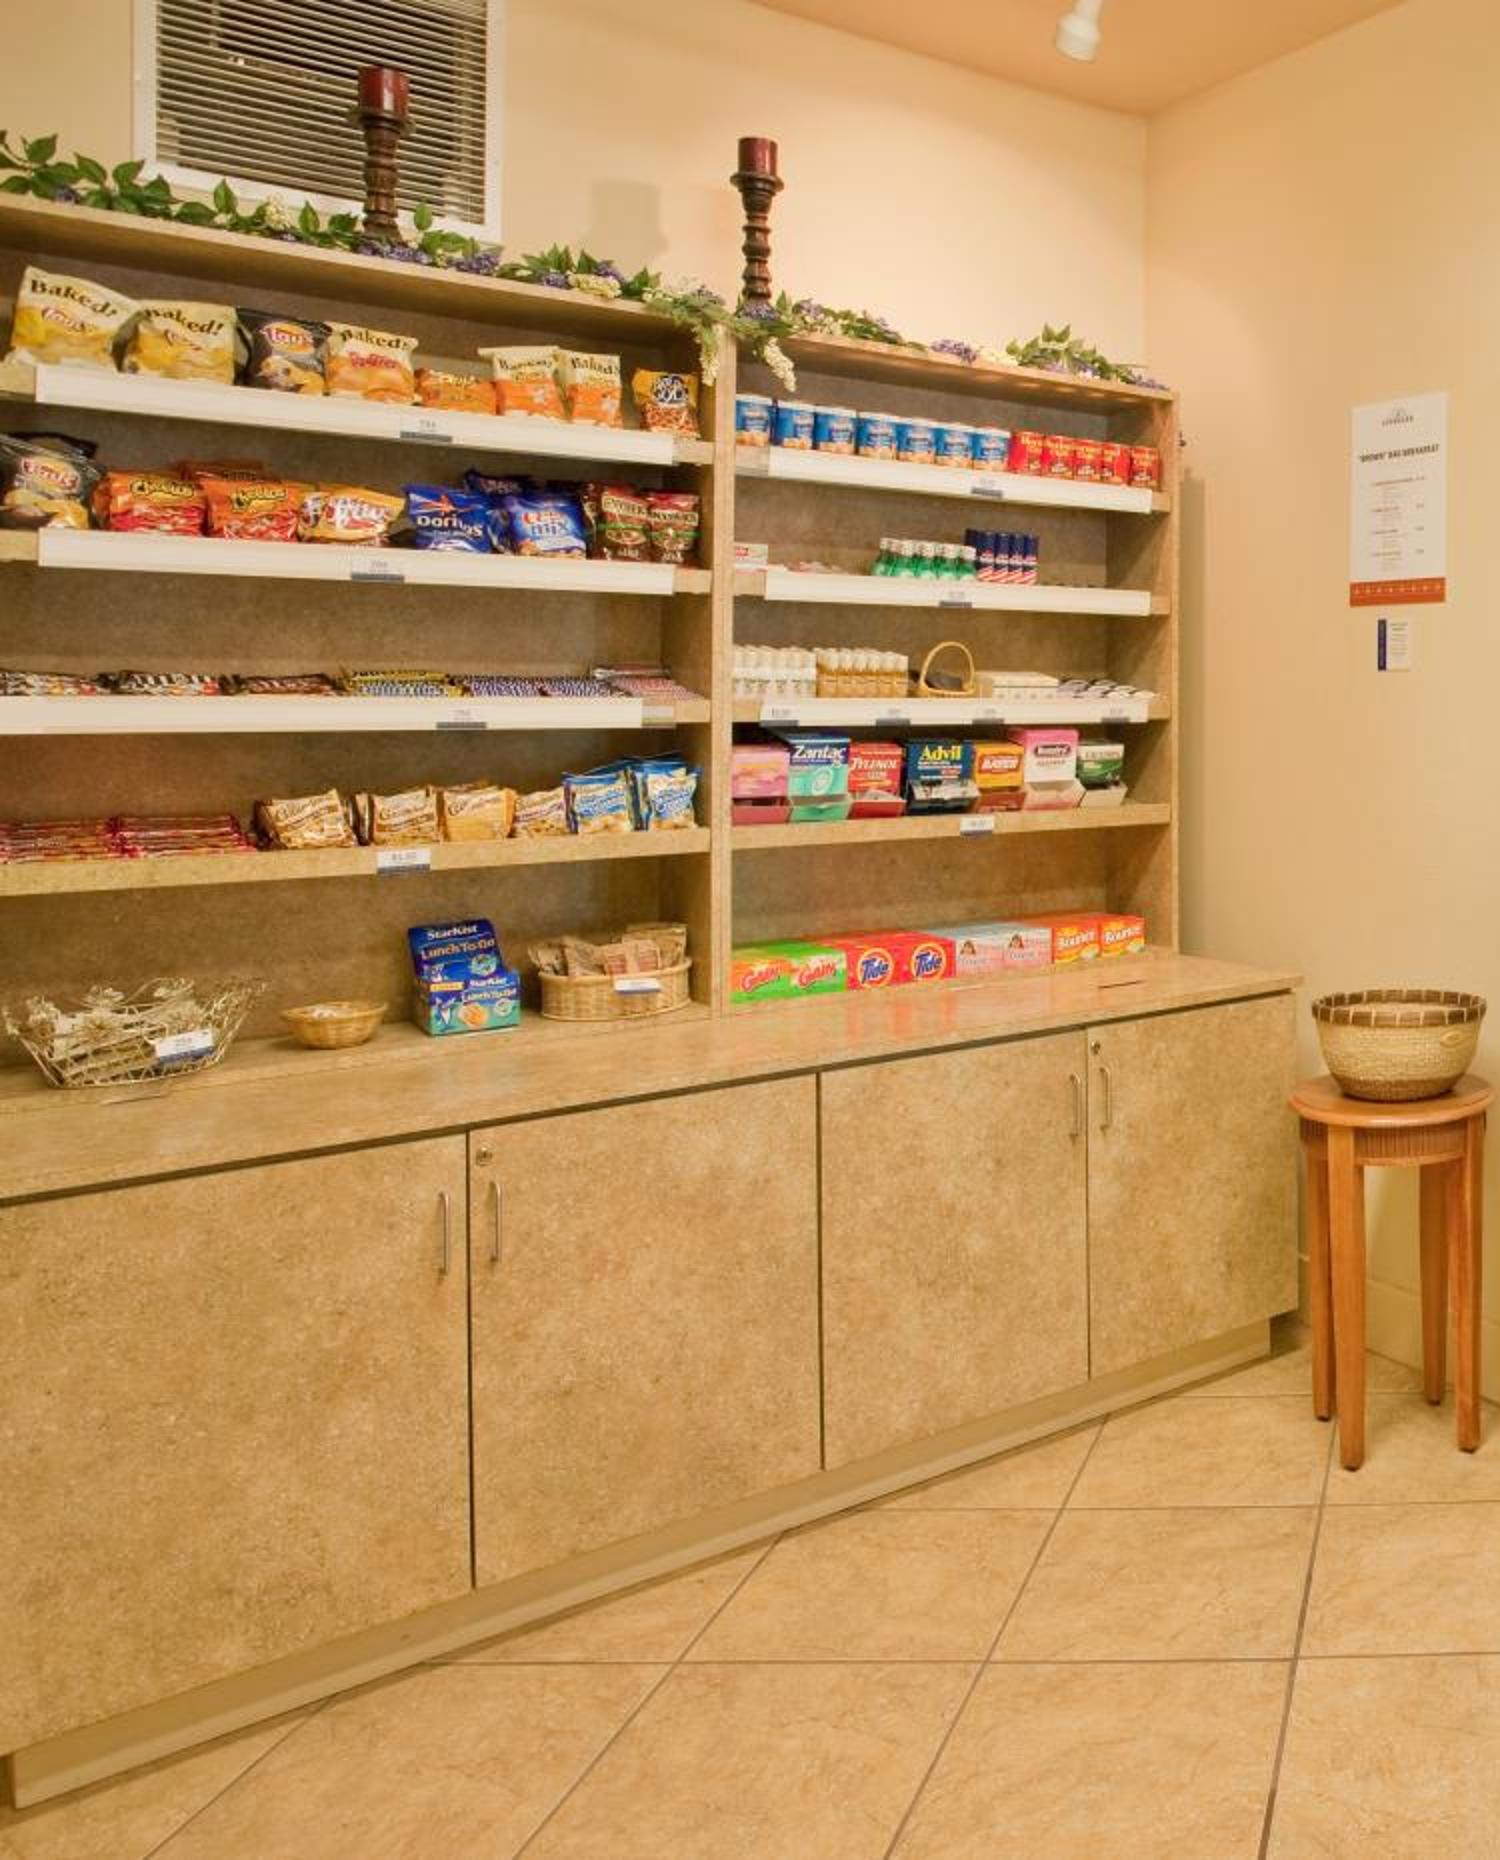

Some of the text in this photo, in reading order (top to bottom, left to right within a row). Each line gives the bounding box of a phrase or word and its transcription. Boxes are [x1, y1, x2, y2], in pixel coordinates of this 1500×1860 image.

[30, 278, 119, 318] Baked!
[416, 514, 484, 538] Doritos
[792, 745, 845, 760] Zantac
[920, 744, 962, 761] Advil
[427, 925, 478, 940] StarKist
[421, 943, 460, 960] Lunch
[860, 958, 889, 984] Tide
[915, 951, 943, 978] Tide
